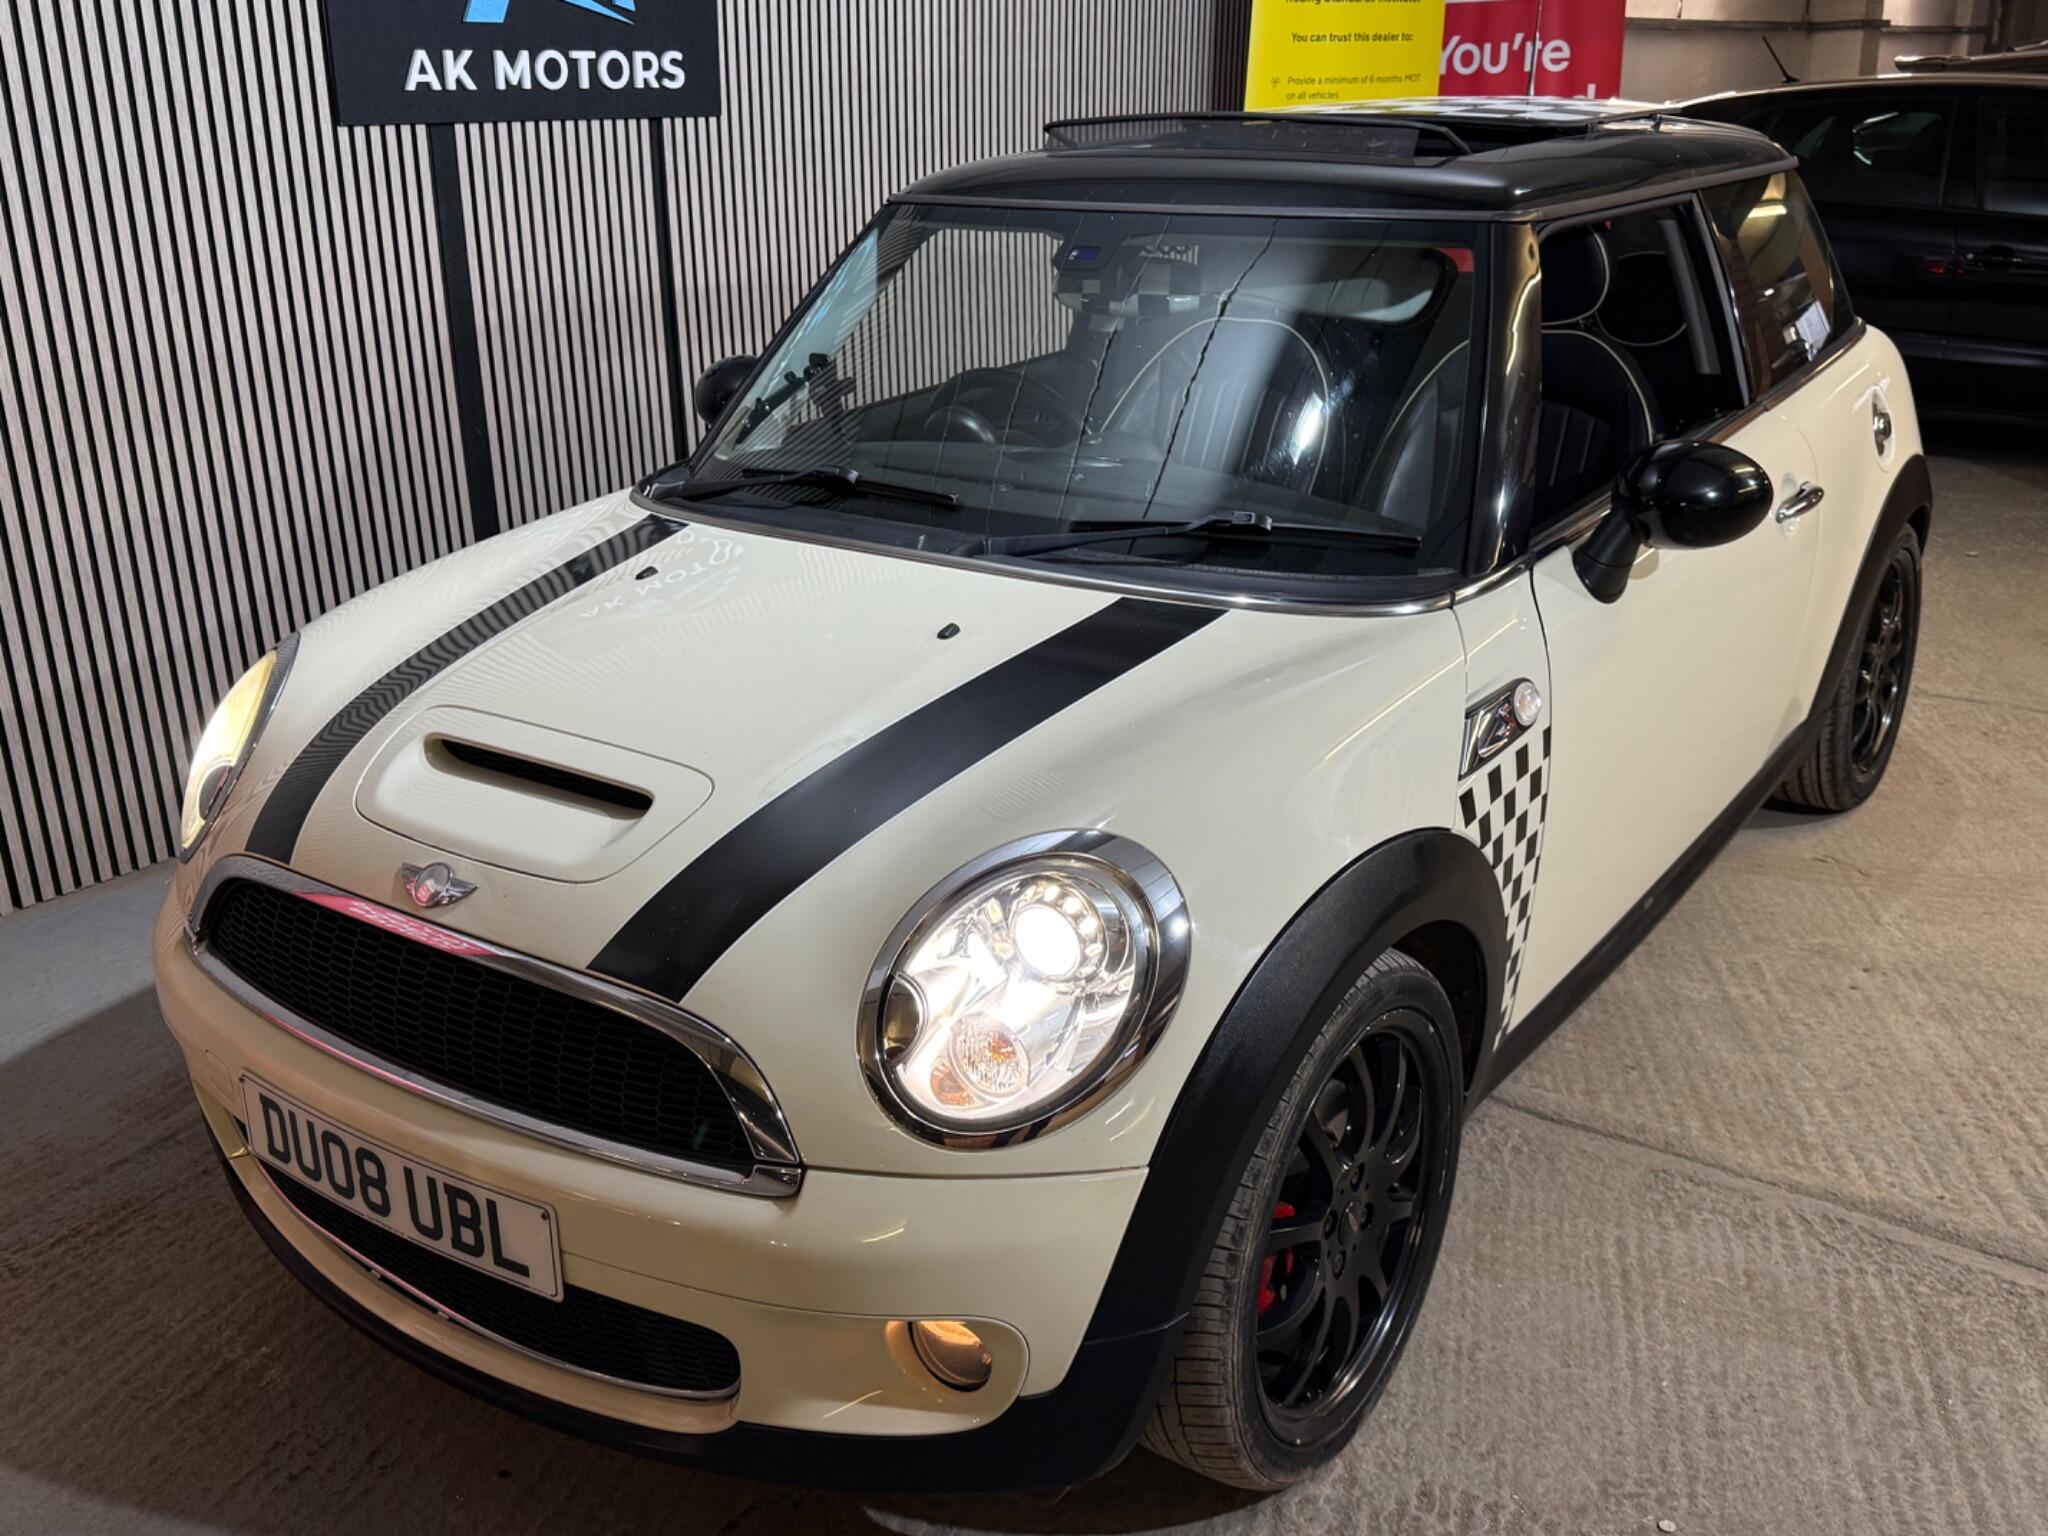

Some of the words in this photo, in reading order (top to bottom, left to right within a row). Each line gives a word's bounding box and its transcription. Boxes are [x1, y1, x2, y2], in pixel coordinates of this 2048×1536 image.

[1292, 32, 1309, 42] You
[1310, 34, 1327, 42] can
[1329, 33, 1352, 42] trust
[1354, 32, 1370, 42] this
[1372, 32, 1400, 42] dealer
[1401, 32, 1413, 41] to:
[404, 49, 478, 92] AK
[493, 49, 686, 90] MOTORS
[1288, 76, 1316, 86] Provide
[1376, 74, 1403, 83] months
[1405, 73, 1421, 82] MOT
[1286, 92, 1296, 100] on
[1297, 91, 1306, 100] all
[1308, 91, 1339, 100] vehicles
[259, 1092, 391, 1218] DU08
[403, 1165, 530, 1279] UBL
